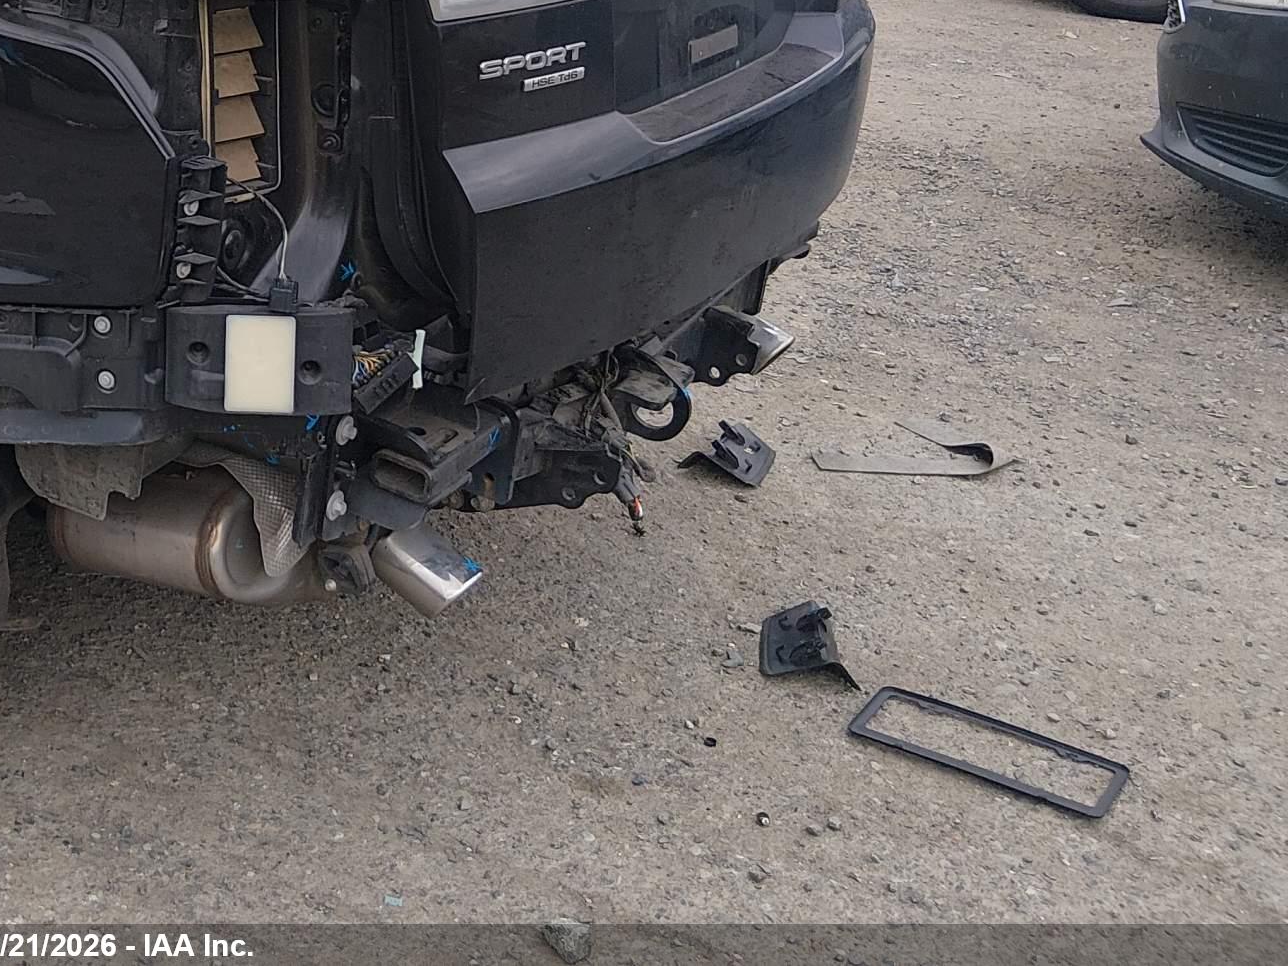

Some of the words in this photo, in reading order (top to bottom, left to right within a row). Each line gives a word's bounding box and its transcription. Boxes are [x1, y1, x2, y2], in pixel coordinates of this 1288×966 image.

[479, 41, 586, 80] SPORT
[531, 76, 557, 89] HSE
[558, 70, 579, 83] Td6
